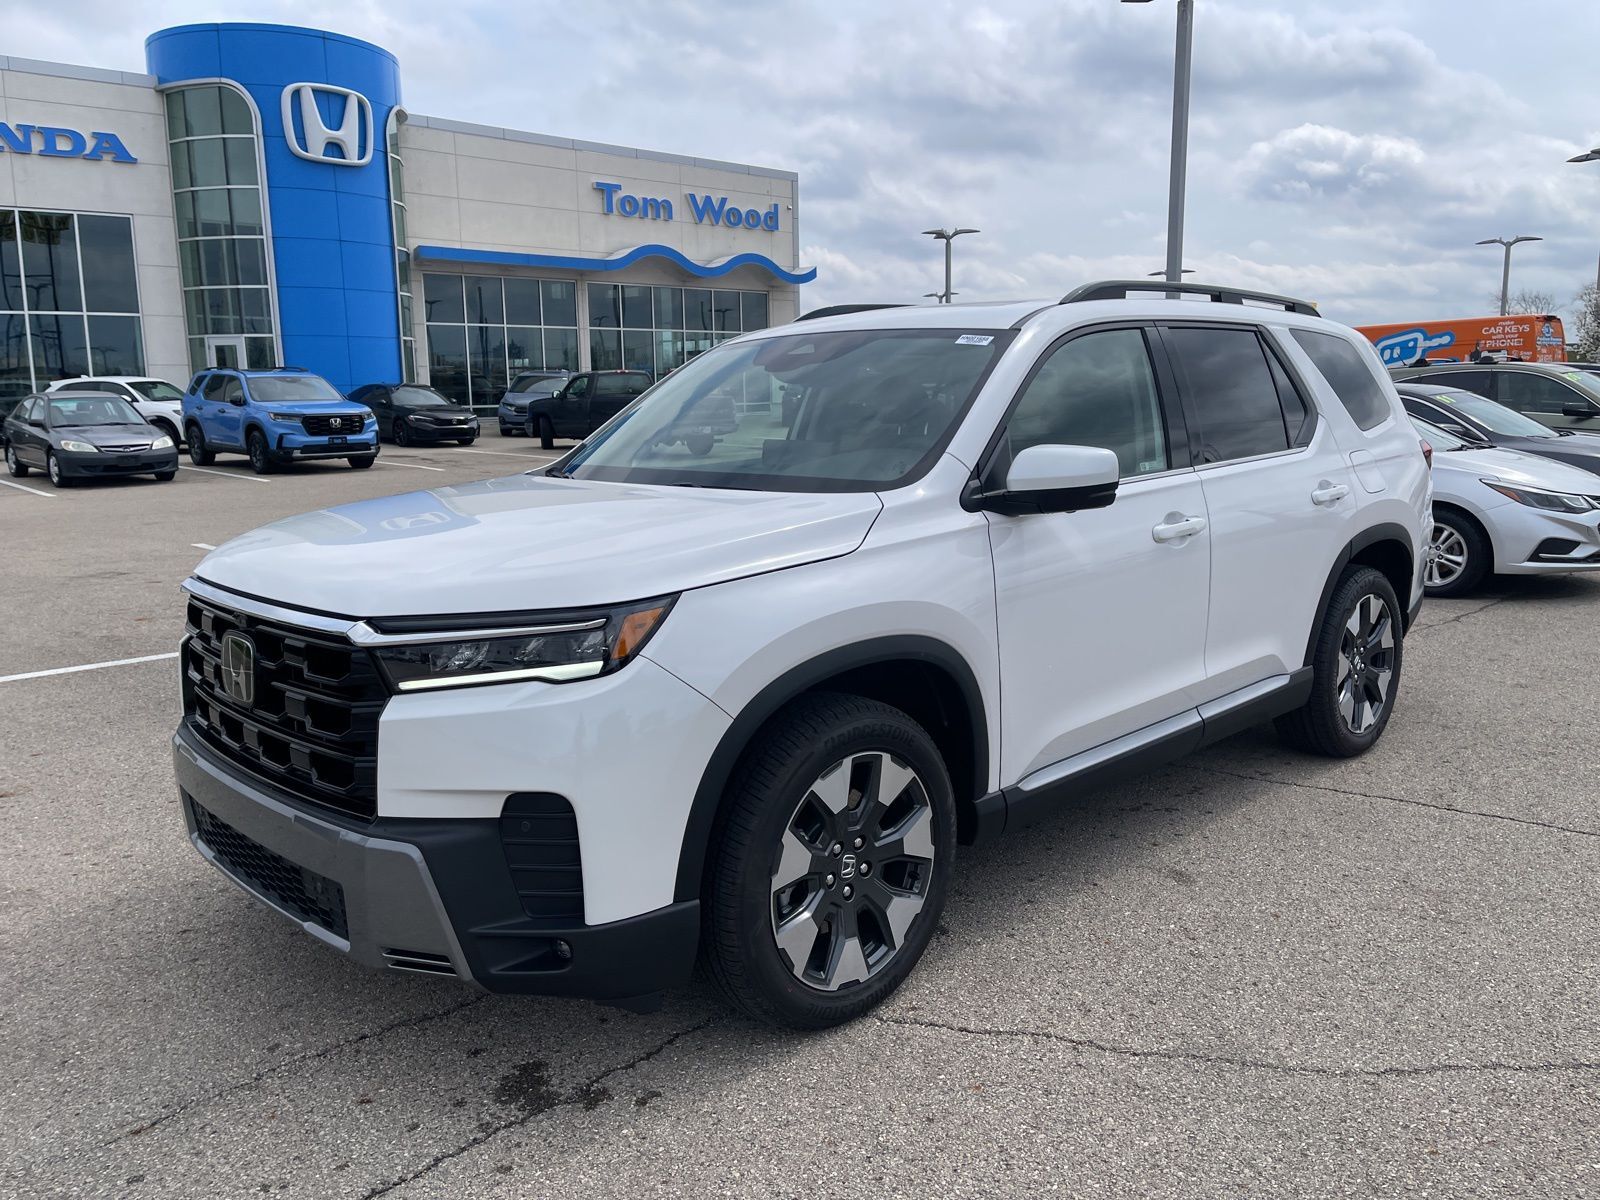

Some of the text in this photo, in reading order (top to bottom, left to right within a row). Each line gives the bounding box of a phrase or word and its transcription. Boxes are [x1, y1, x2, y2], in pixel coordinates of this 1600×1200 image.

[0, 121, 138, 164] NDA
[593, 181, 780, 232] Tom Wood
[1505, 324, 1530, 333] KEYS
[1486, 338, 1523, 348] PHONE!
